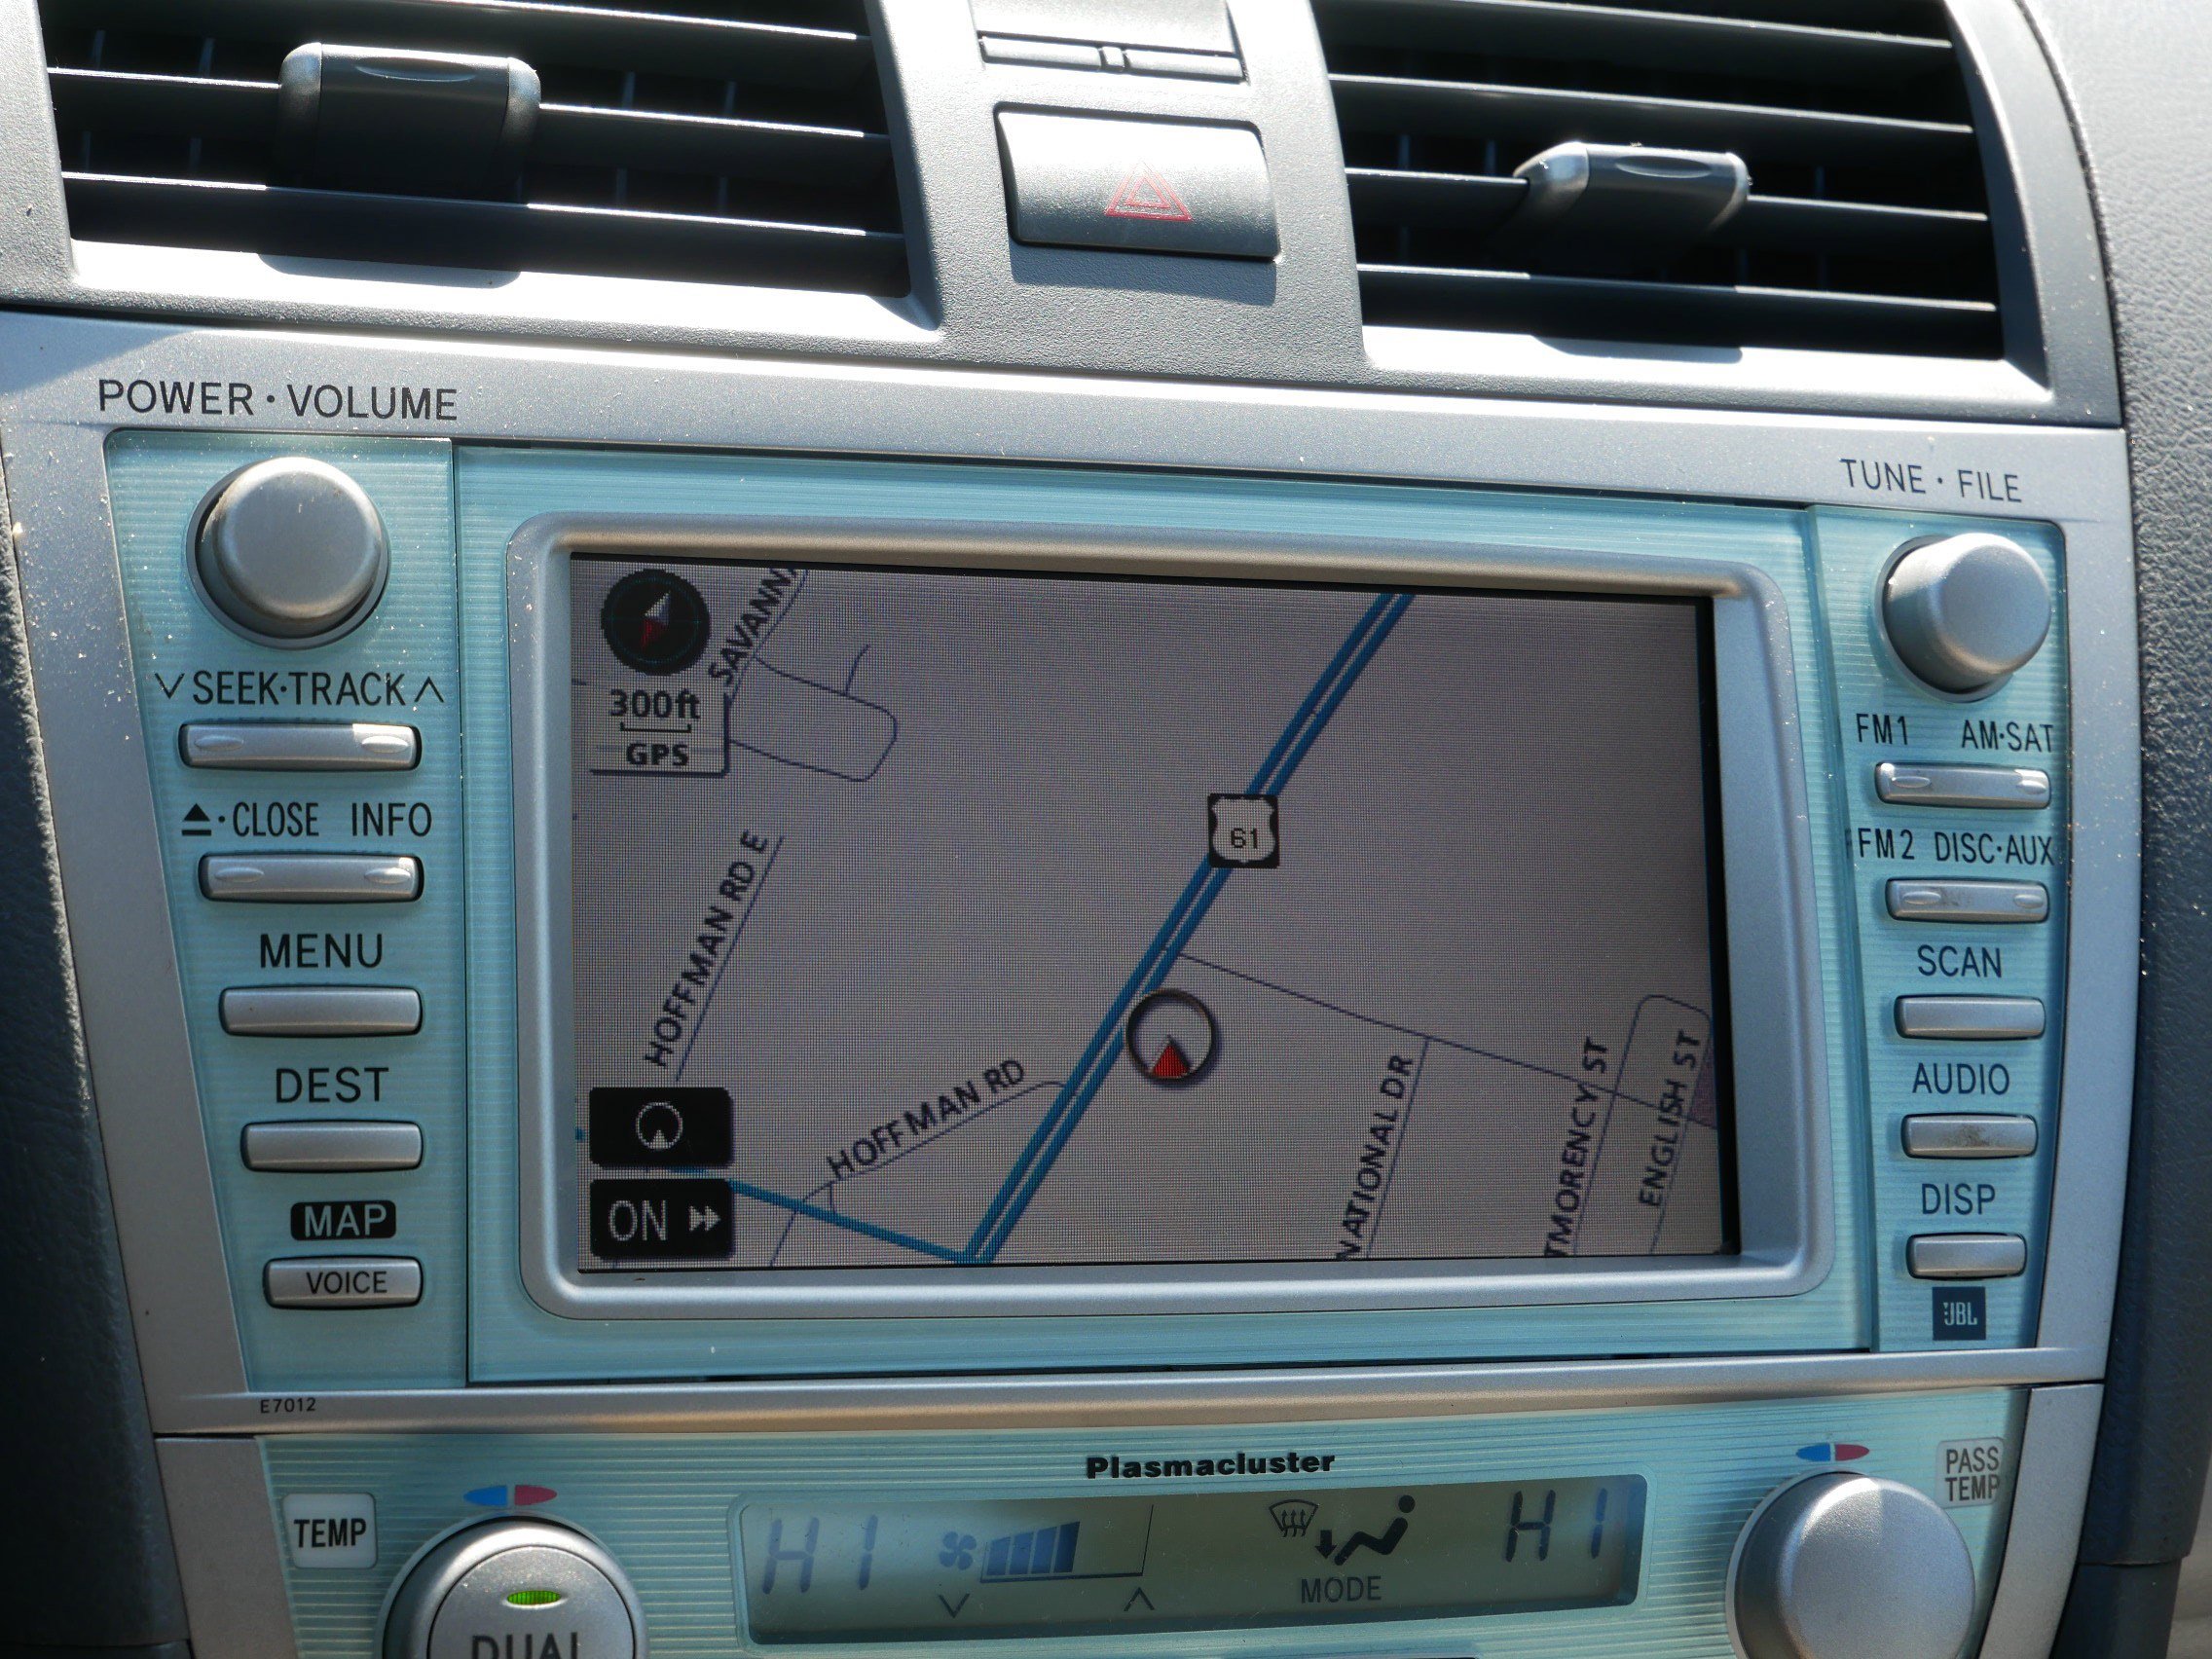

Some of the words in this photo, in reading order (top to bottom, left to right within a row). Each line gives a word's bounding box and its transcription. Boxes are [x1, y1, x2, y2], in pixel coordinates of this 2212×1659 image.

[98, 379, 254, 416] POWER
[287, 384, 459, 421] VOLUME
[1840, 458, 1927, 495] TUNE
[1957, 468, 2022, 502] FILE
[708, 568, 796, 685] SAVANN
[608, 687, 701, 719] 300ft
[1856, 713, 1909, 746] FM1
[625, 743, 689, 766] GPS
[350, 802, 432, 837] INFO
[1230, 828, 1260, 850] 61
[1858, 828, 1916, 861] FM2
[259, 933, 384, 969] MENU
[644, 905, 733, 1068] HOFFMAN
[719, 861, 756, 902] RD
[740, 829, 768, 854] E
[1916, 944, 2004, 978] SCAN
[1581, 1035, 1609, 1075] ST
[276, 1067, 389, 1103] DEST
[1911, 1062, 2011, 1096] AUDIO
[826, 1084, 983, 1181] HOFFMAN
[980, 1058, 1026, 1100] RD
[1638, 1078, 1686, 1207] ENGLISH
[1672, 1028, 1701, 1069] ST
[1336, 1110, 1399, 1261] NATIONAL
[1380, 1054, 1414, 1099] DR
[1921, 1182, 1997, 1216] DISP
[303, 1203, 387, 1237] MAP
[608, 1199, 669, 1242] ON
[305, 1270, 388, 1295] VOICE
[1942, 1301, 1978, 1328] JBL
[259, 1396, 317, 1415] E7012
[1086, 1451, 1336, 1479] Plasmacluster
[1945, 1443, 2001, 1475] PASS
[1944, 1470, 2001, 1503] TEMP
[293, 1517, 367, 1549] TEMP
[1300, 1574, 1383, 1604] MODE
